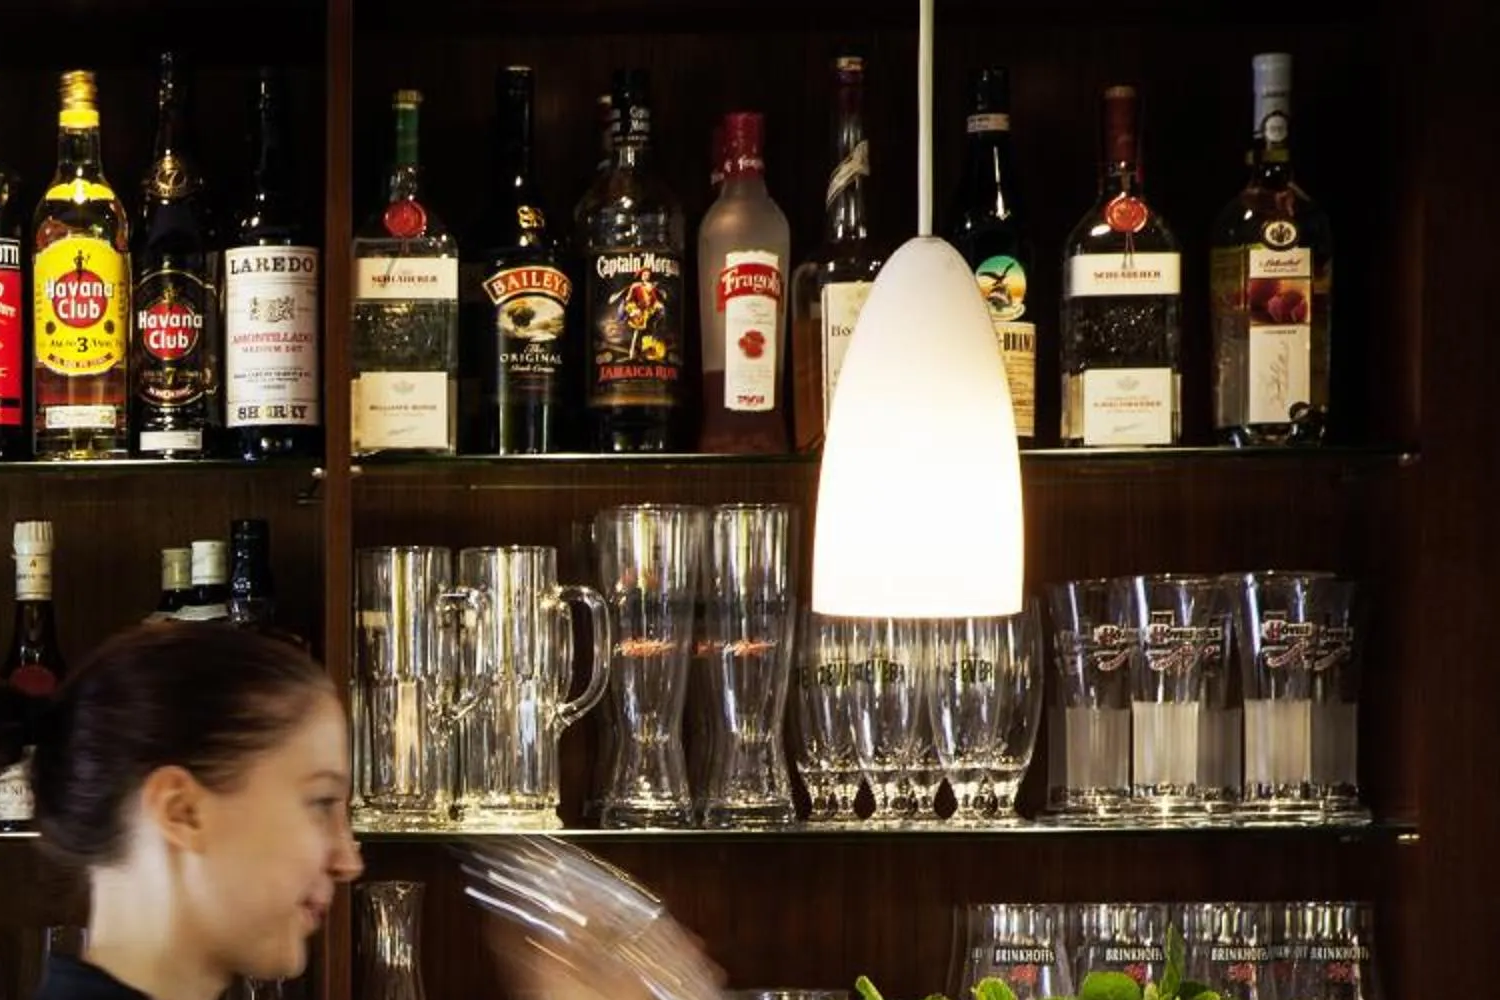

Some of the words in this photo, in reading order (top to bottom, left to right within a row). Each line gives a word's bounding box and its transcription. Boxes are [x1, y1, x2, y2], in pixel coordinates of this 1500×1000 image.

[230, 255, 315, 275] LAREDO
[596, 252, 641, 278] Captain
[45, 280, 115, 299] Havana
[492, 271, 569, 297] BAILEYS
[57, 297, 101, 319] Club
[138, 310, 203, 329] Havana
[76, 336, 89, 353] 3
[148, 329, 189, 349] Club
[500, 353, 563, 364] ORIGINAL
